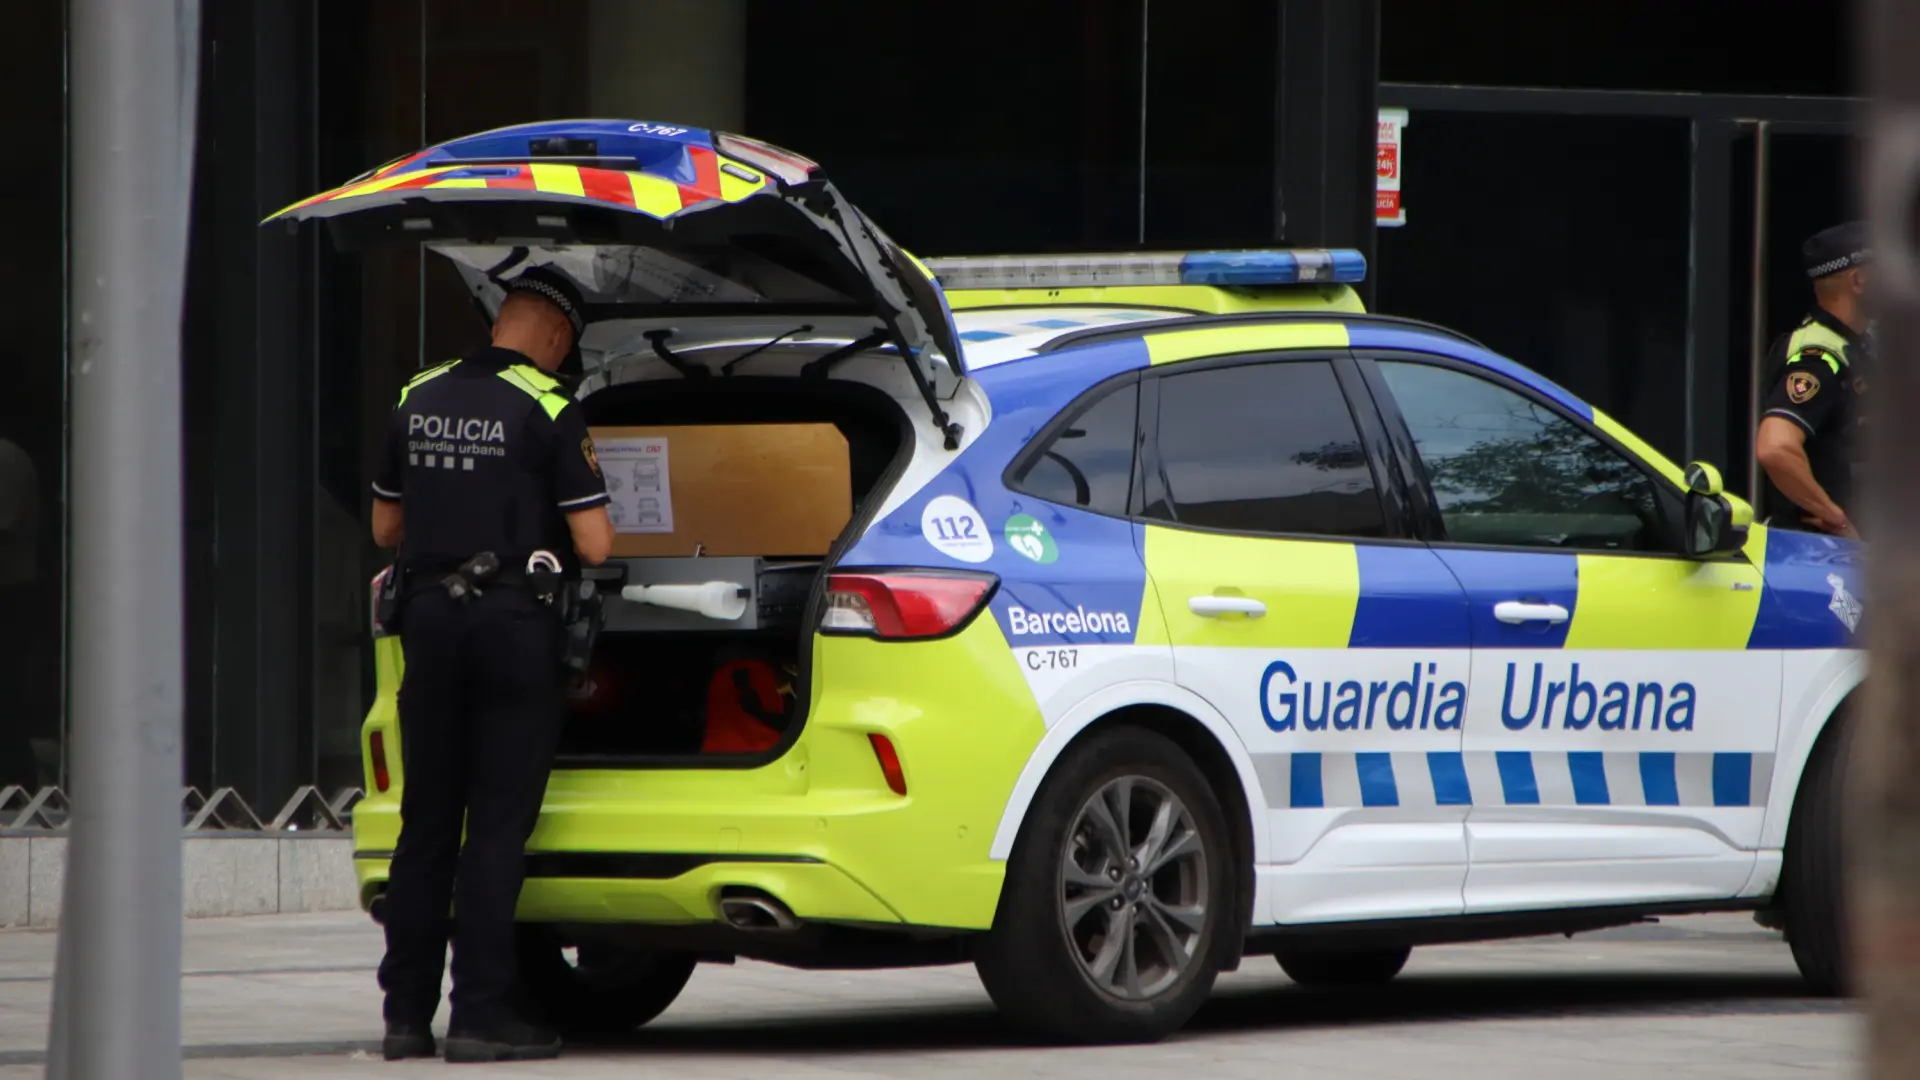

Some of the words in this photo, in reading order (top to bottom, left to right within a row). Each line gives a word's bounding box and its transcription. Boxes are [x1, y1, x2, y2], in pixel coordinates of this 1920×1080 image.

[628, 123, 688, 136] C-767
[408, 413, 505, 442] POLICIA
[459, 442, 505, 457] urbana
[931, 515, 979, 541] 112
[1008, 604, 1131, 635] Barcelona
[1027, 649, 1079, 671] C-767
[1259, 660, 1467, 733] Guardia
[1500, 662, 1697, 732] Urbana
